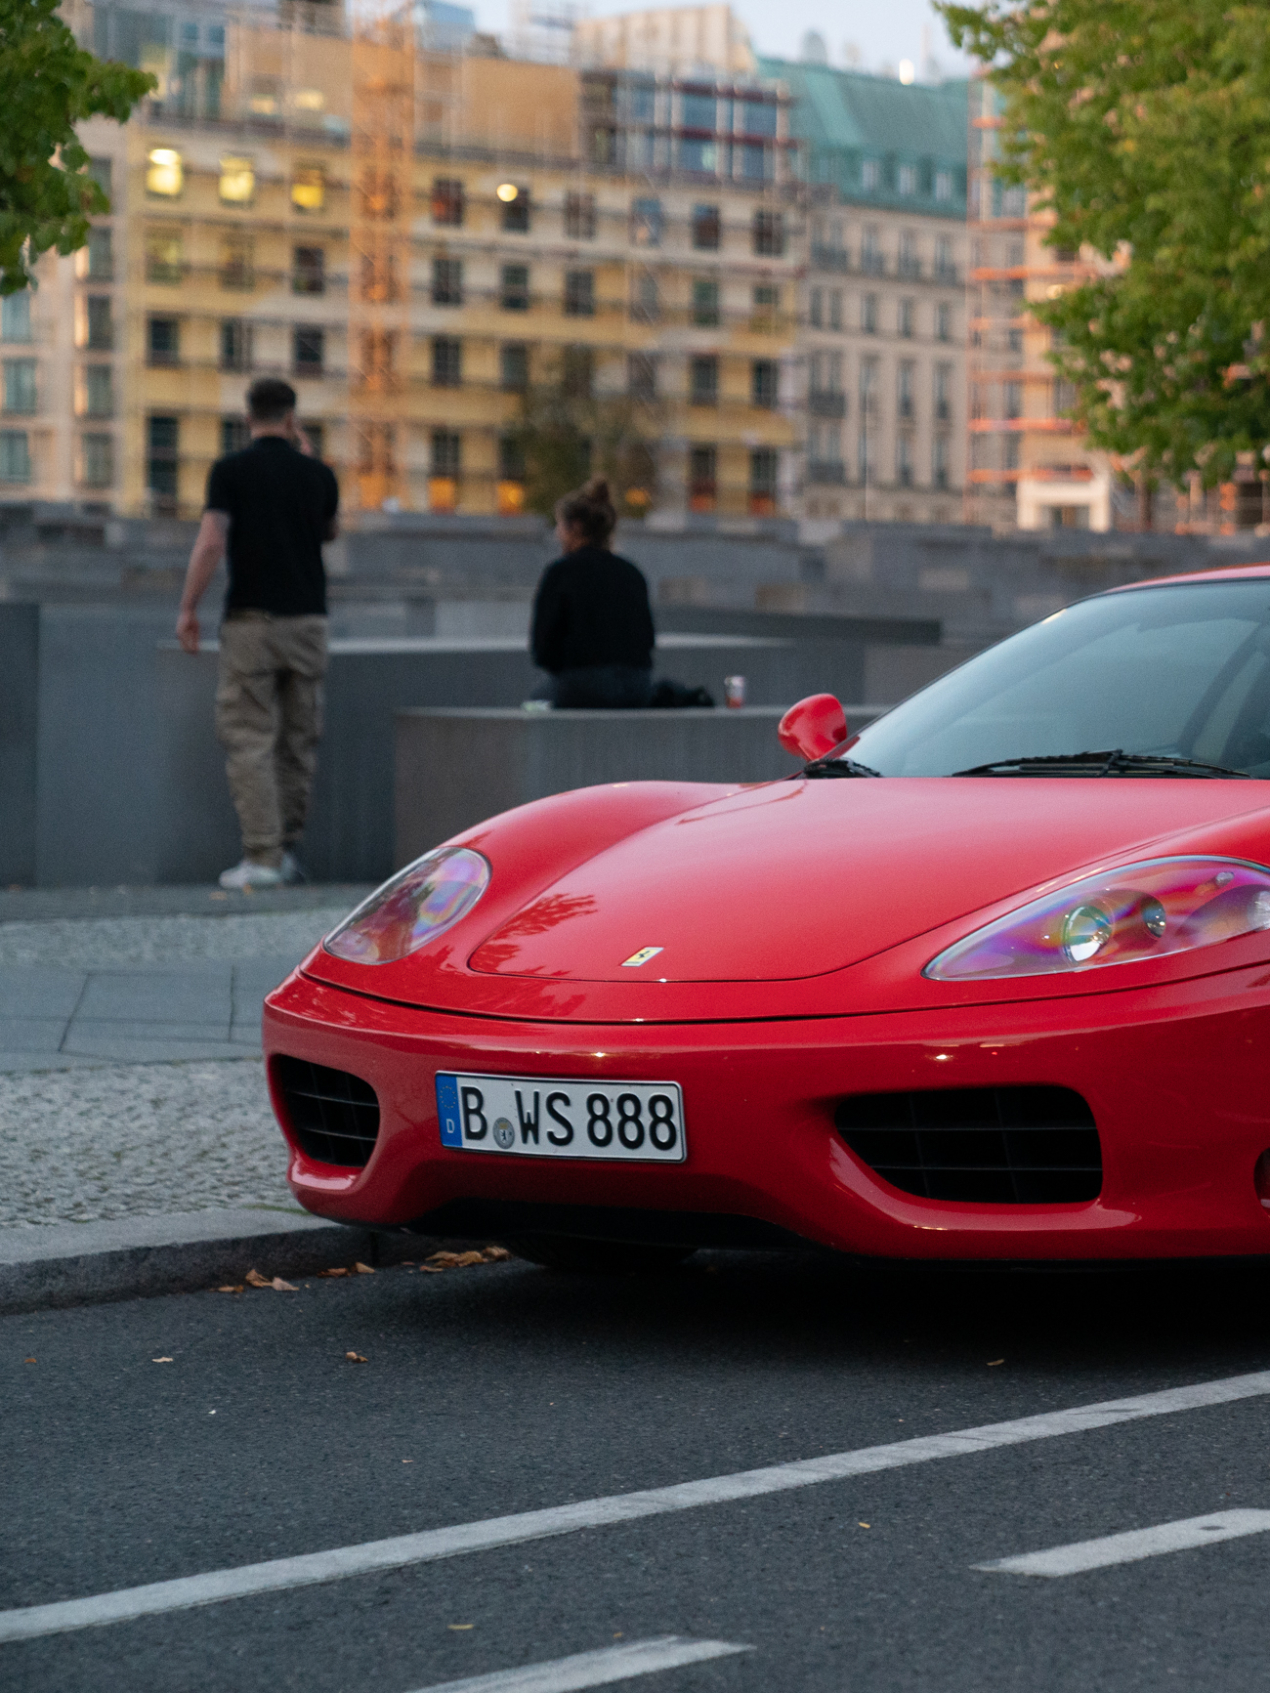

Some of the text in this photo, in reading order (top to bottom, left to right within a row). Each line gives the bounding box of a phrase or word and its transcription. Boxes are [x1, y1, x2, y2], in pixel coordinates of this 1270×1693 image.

[446, 1118, 455, 1134] D
[461, 1086, 677, 1151] B WS 888
